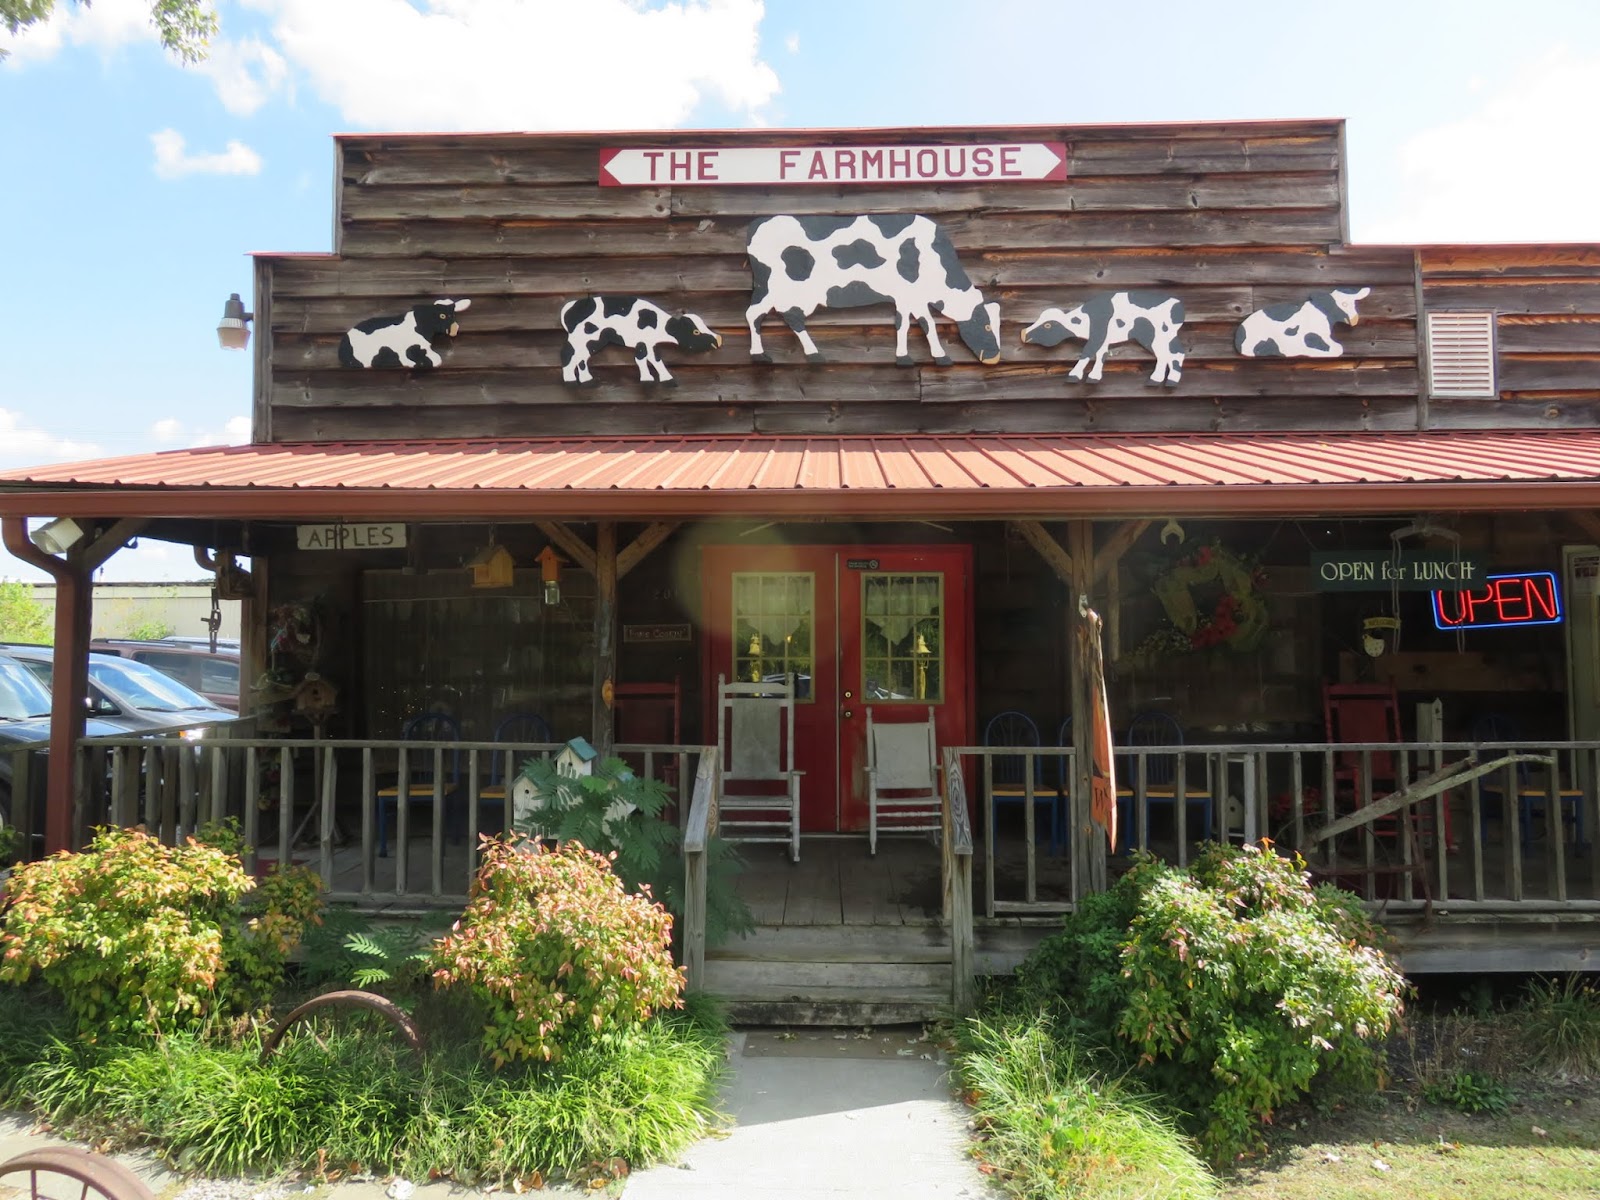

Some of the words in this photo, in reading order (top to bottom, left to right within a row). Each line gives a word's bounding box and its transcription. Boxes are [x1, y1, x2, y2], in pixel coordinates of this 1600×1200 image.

[643, 151, 719, 181] THE
[779, 146, 1022, 180] FARMHOUSE
[307, 526, 394, 547] APPLES
[1320, 561, 1374, 581] OPEN
[1381, 560, 1406, 580] for
[1413, 561, 1476, 580] LUNCH
[1438, 578, 1557, 624] OPEN
